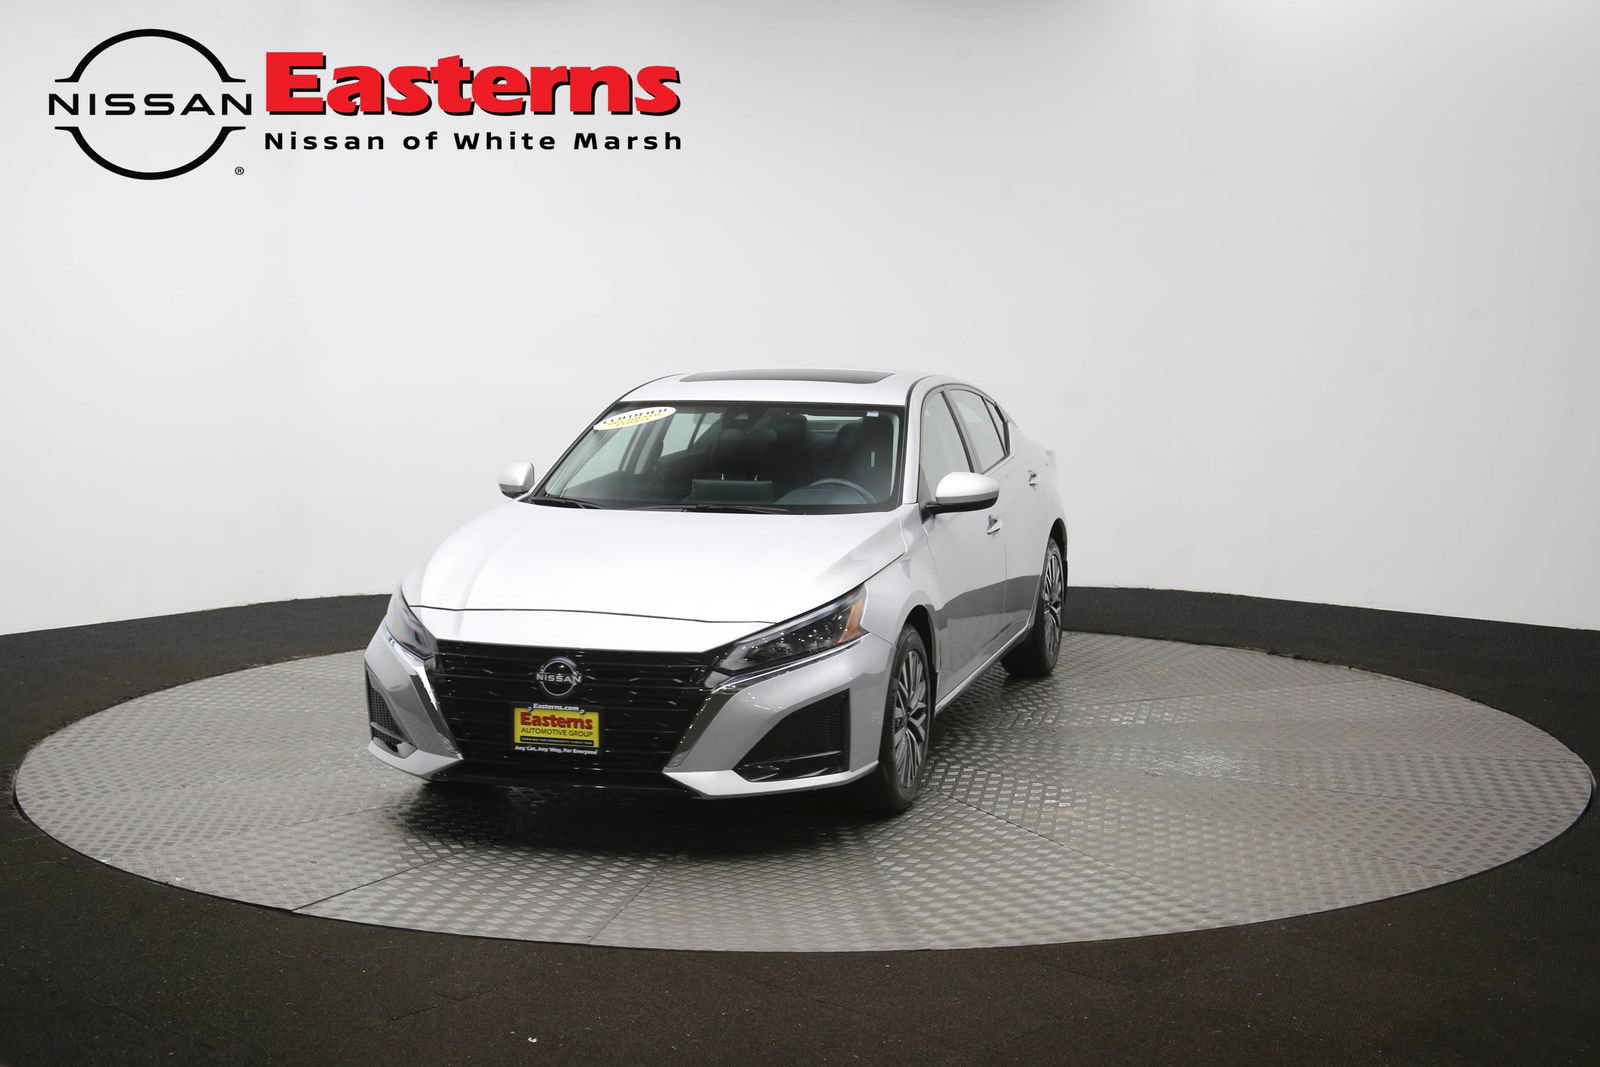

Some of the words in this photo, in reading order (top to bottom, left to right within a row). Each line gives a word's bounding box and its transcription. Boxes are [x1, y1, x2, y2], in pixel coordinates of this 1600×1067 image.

[536, 674, 582, 684] NISSAN
[533, 703, 579, 711] Easterns.com
[520, 712, 593, 730] Easterns
[521, 728, 567, 736] AUTOMOTIVE
